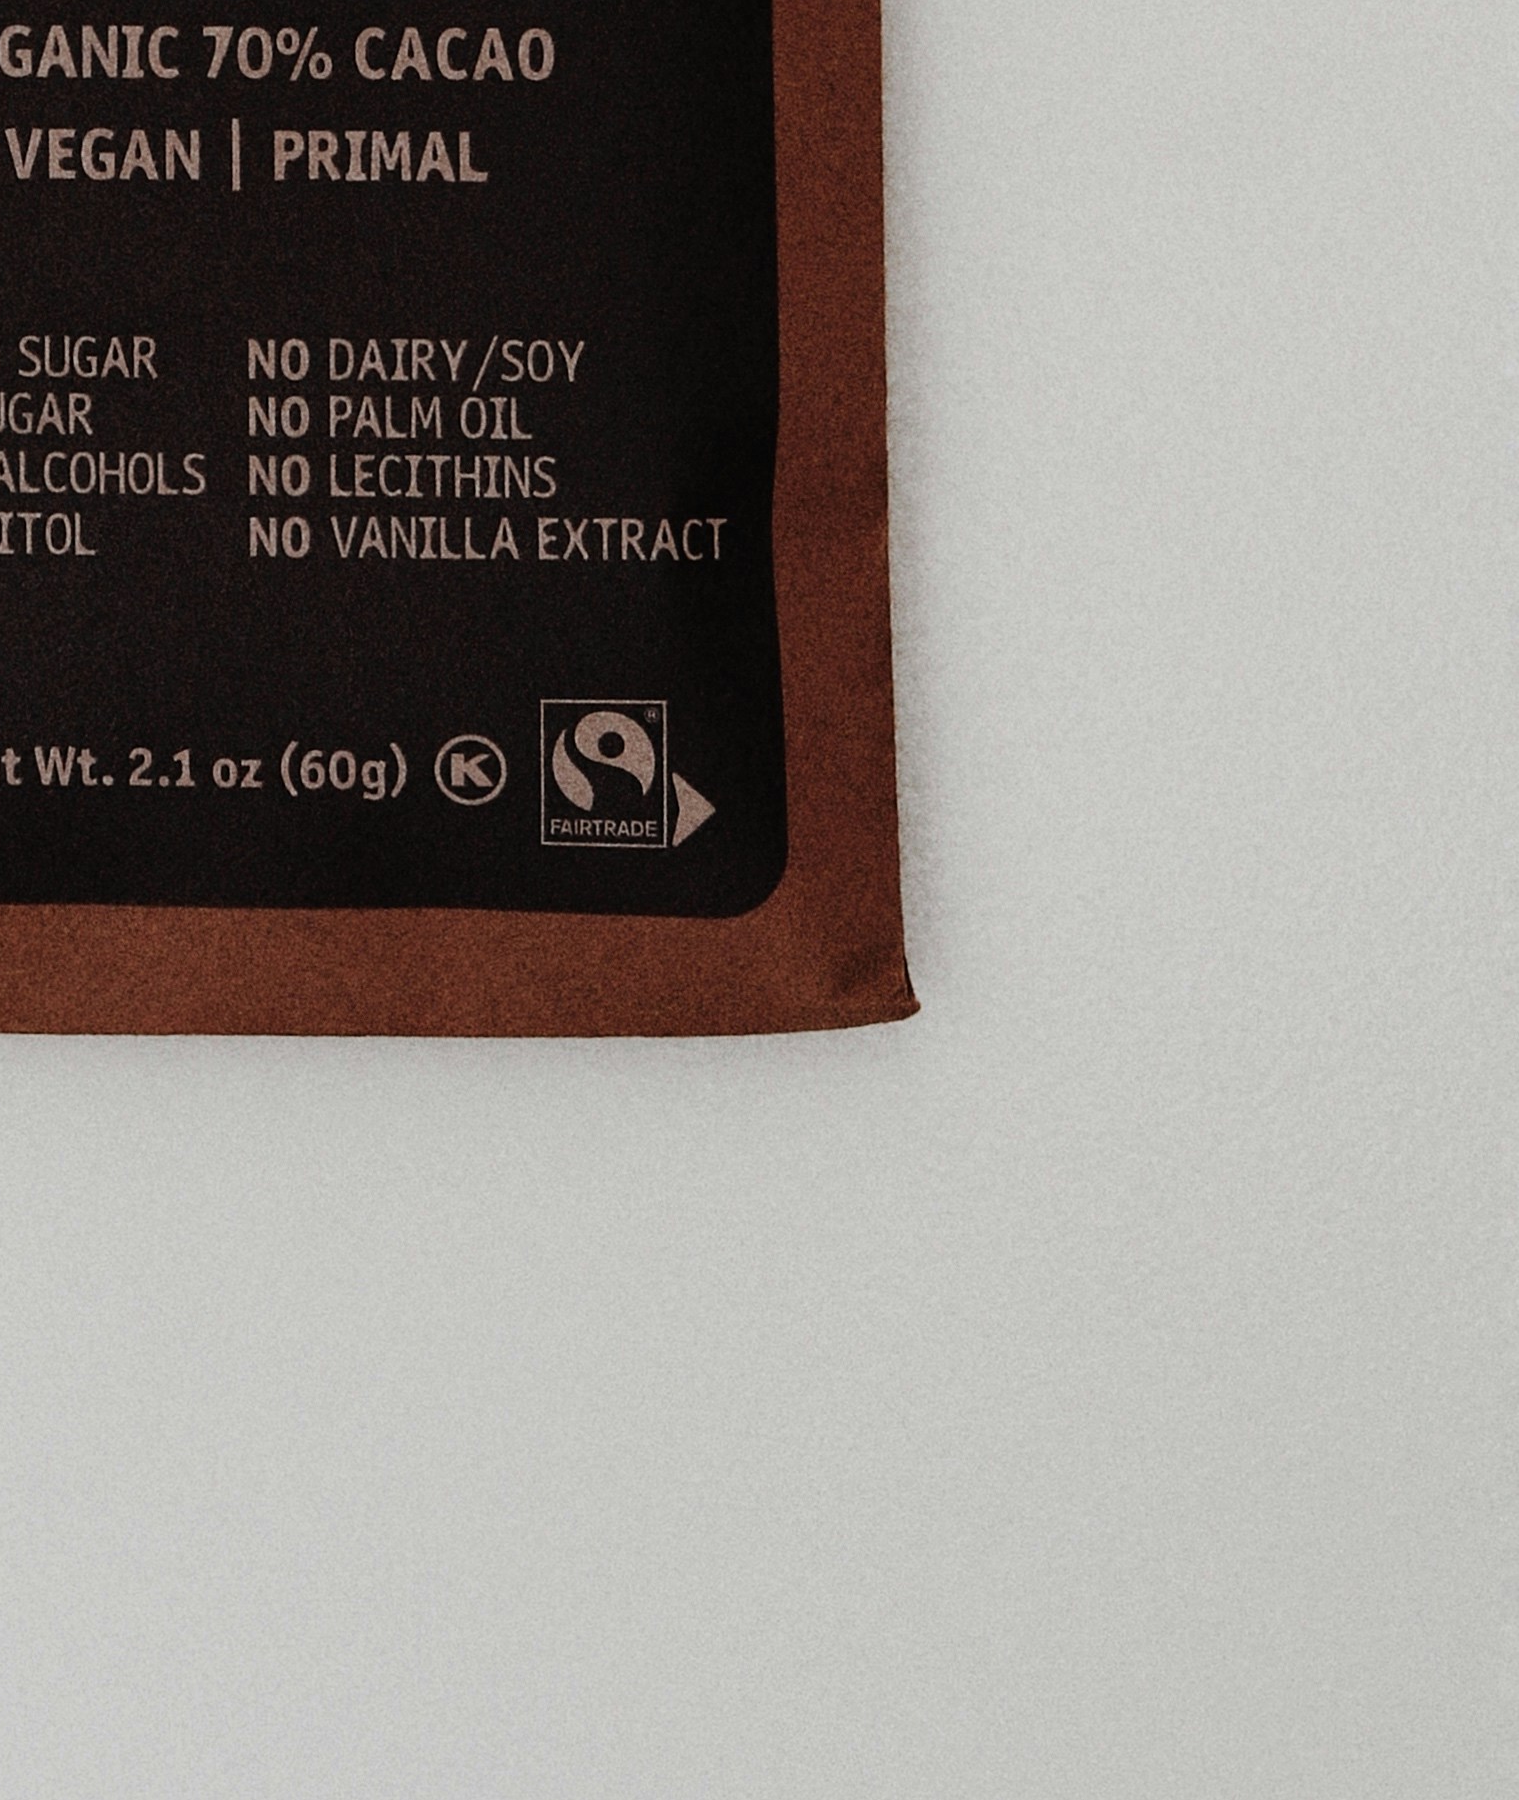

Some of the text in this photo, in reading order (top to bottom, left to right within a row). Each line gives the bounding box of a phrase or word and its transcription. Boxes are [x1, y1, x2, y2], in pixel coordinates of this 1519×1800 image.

[202, 25, 333, 81] 70%
[354, 27, 555, 81] CACAO
[5, 127, 201, 180] VEGAN
[273, 130, 488, 183] PRIMAL
[18, 335, 158, 379] SUGAR
[248, 336, 585, 391] NO DAIRY/SOY
[248, 395, 532, 440] NO PALM OIL
[248, 454, 557, 499] NO LECITHINS
[249, 516, 725, 561] NO VANILLA EXTRACT
[34, 746, 114, 786] Wt.
[129, 747, 195, 787] 2.1
[212, 757, 262, 788] oz
[280, 741, 408, 801] (60g)
[550, 818, 656, 837] FAIRTRADE
